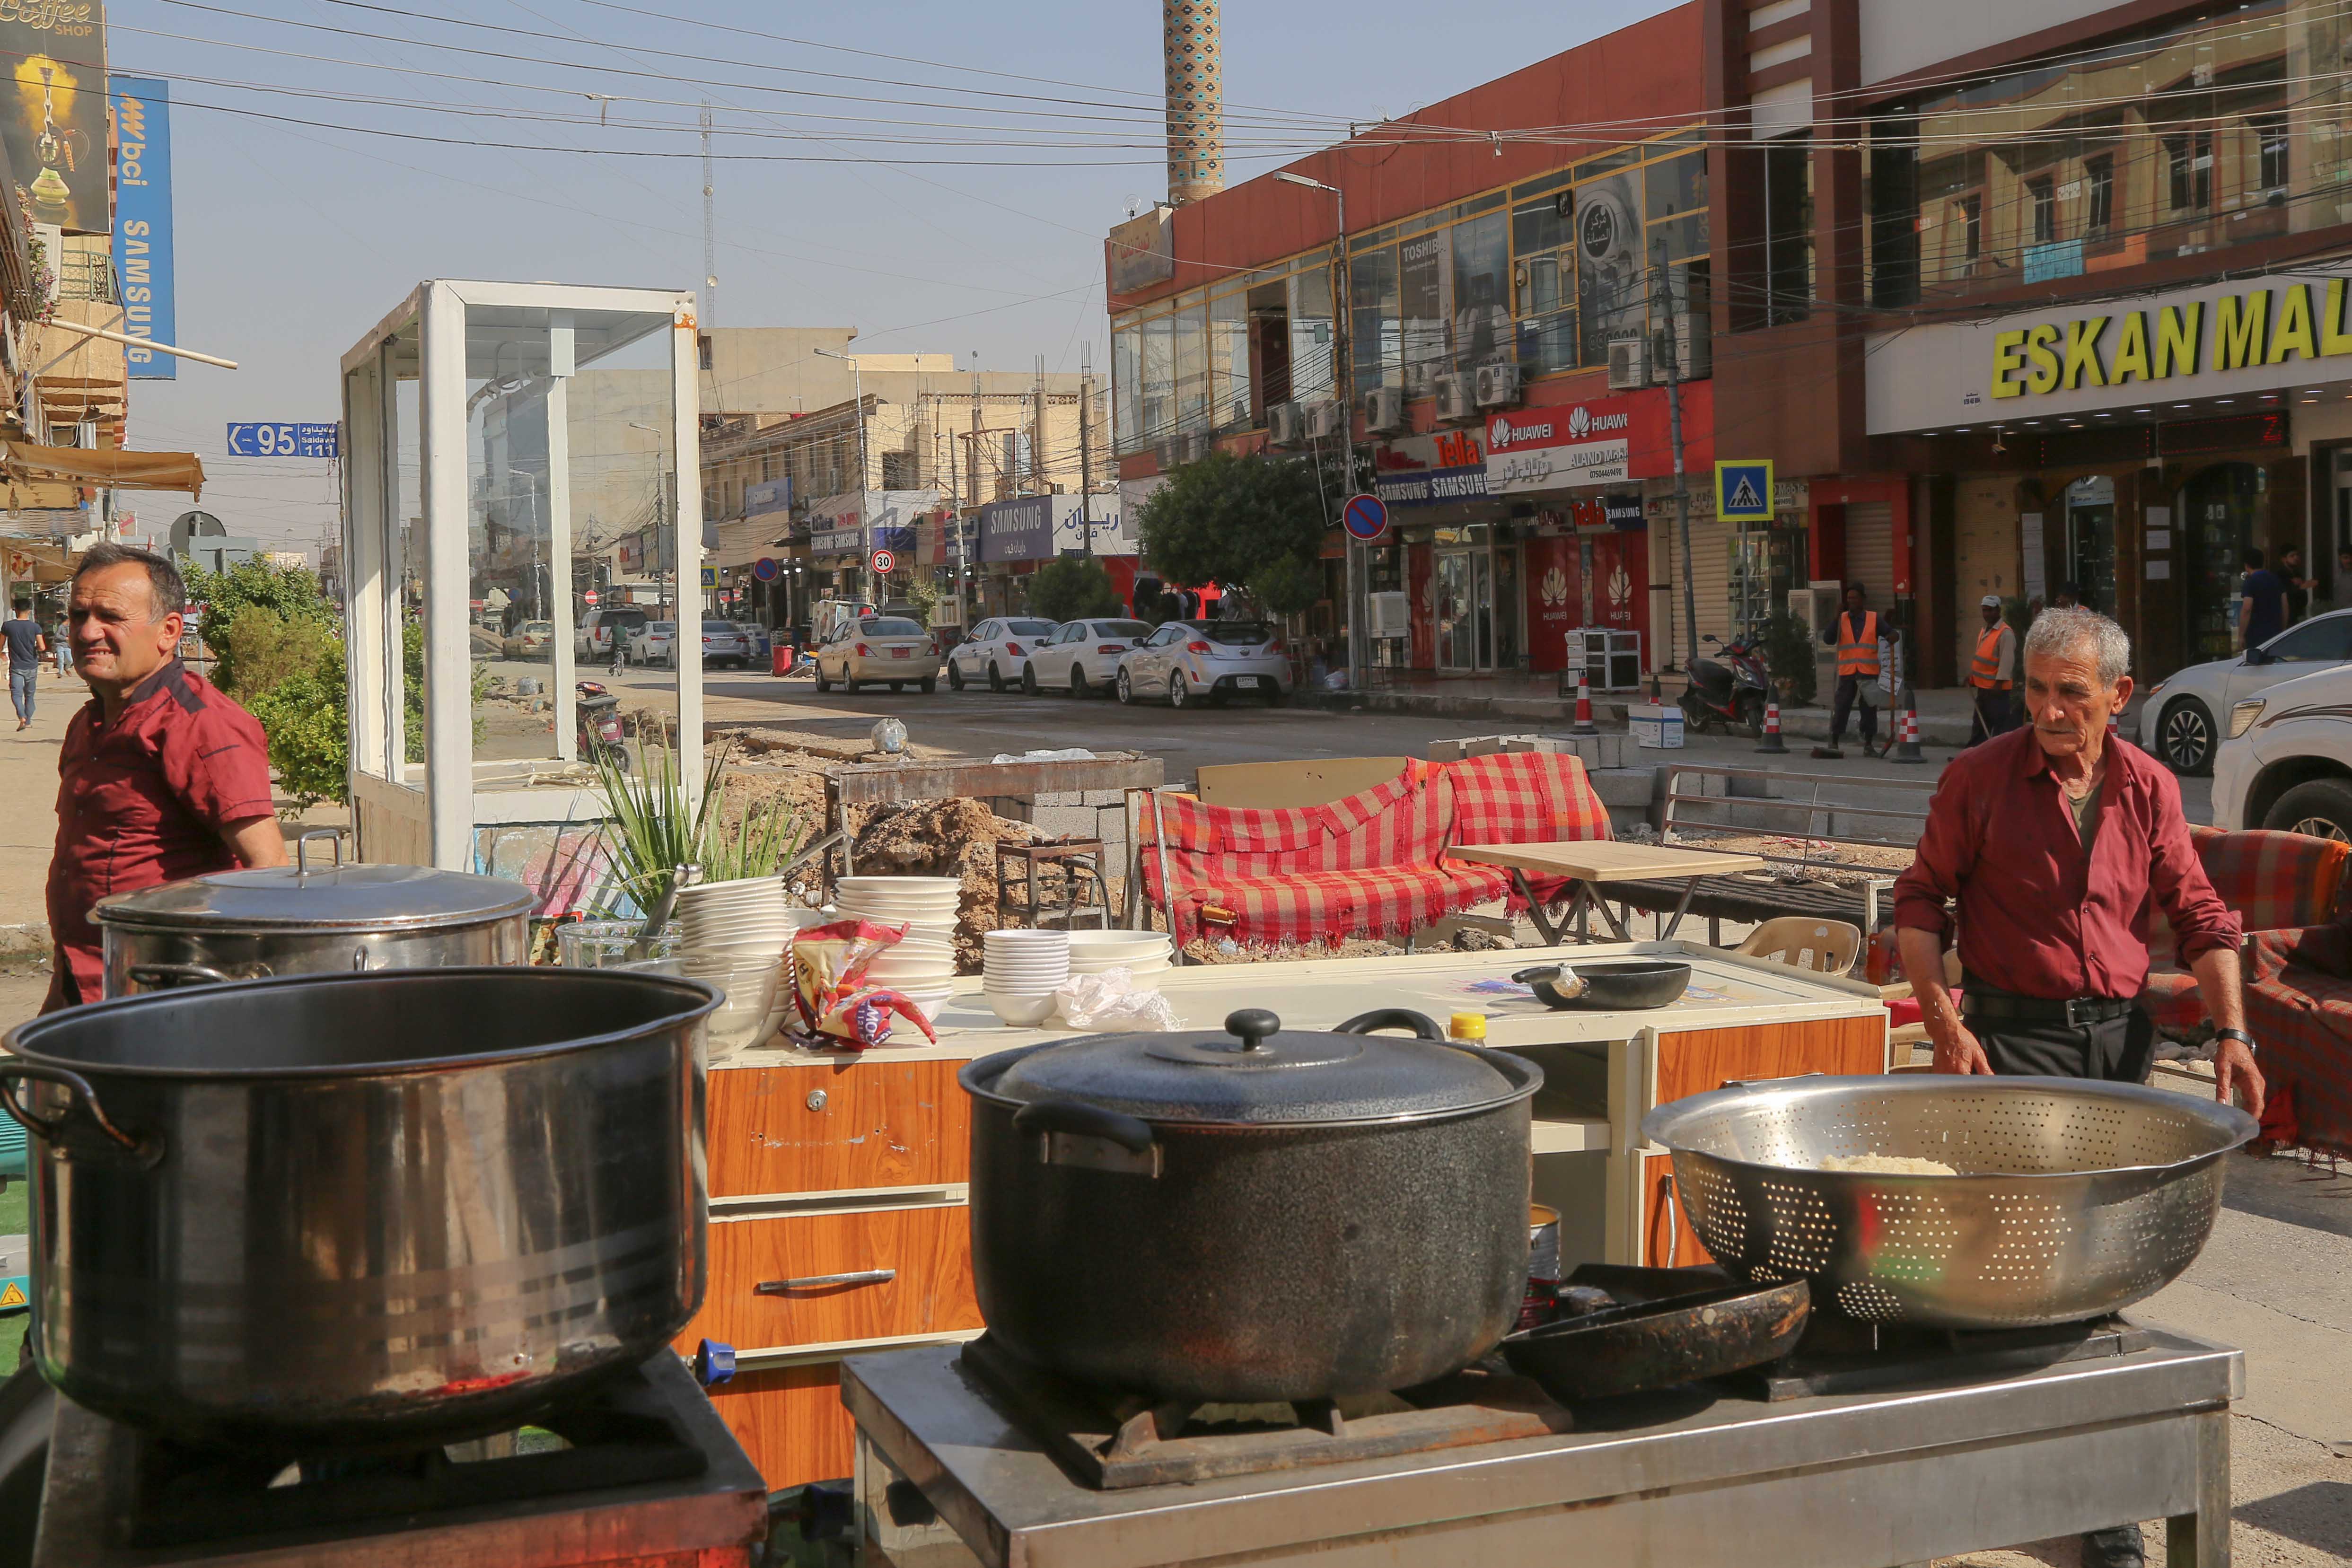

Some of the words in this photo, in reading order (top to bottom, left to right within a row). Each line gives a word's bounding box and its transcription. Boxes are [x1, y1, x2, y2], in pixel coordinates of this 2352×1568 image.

[54, 24, 92, 36] SHOP
[121, 142, 148, 184] bci
[1403, 237, 1446, 262] TOSHIBA
[123, 219, 152, 363] SAMSUNG
[1991, 301, 2205, 399] ESKAN
[257, 425, 296, 455] 95
[1512, 423, 1552, 442] HUAWEI
[306, 445, 333, 456] 111
[1432, 430, 1480, 468] Tella
[1571, 451, 1602, 467] ALAND
[1378, 482, 1428, 502] SAMSUNG
[991, 505, 1041, 534] SAMSUNG
[1607, 506, 1640, 519] SAMSUNG
[811, 534, 833, 551] SAMSUNG
[835, 532, 859, 549] SAMSUNG
[947, 544, 970, 557] SAMNG
[877, 557, 890, 567] 30
[1543, 611, 1567, 621] HUAWEI
[1610, 611, 1631, 621] HUAEI
